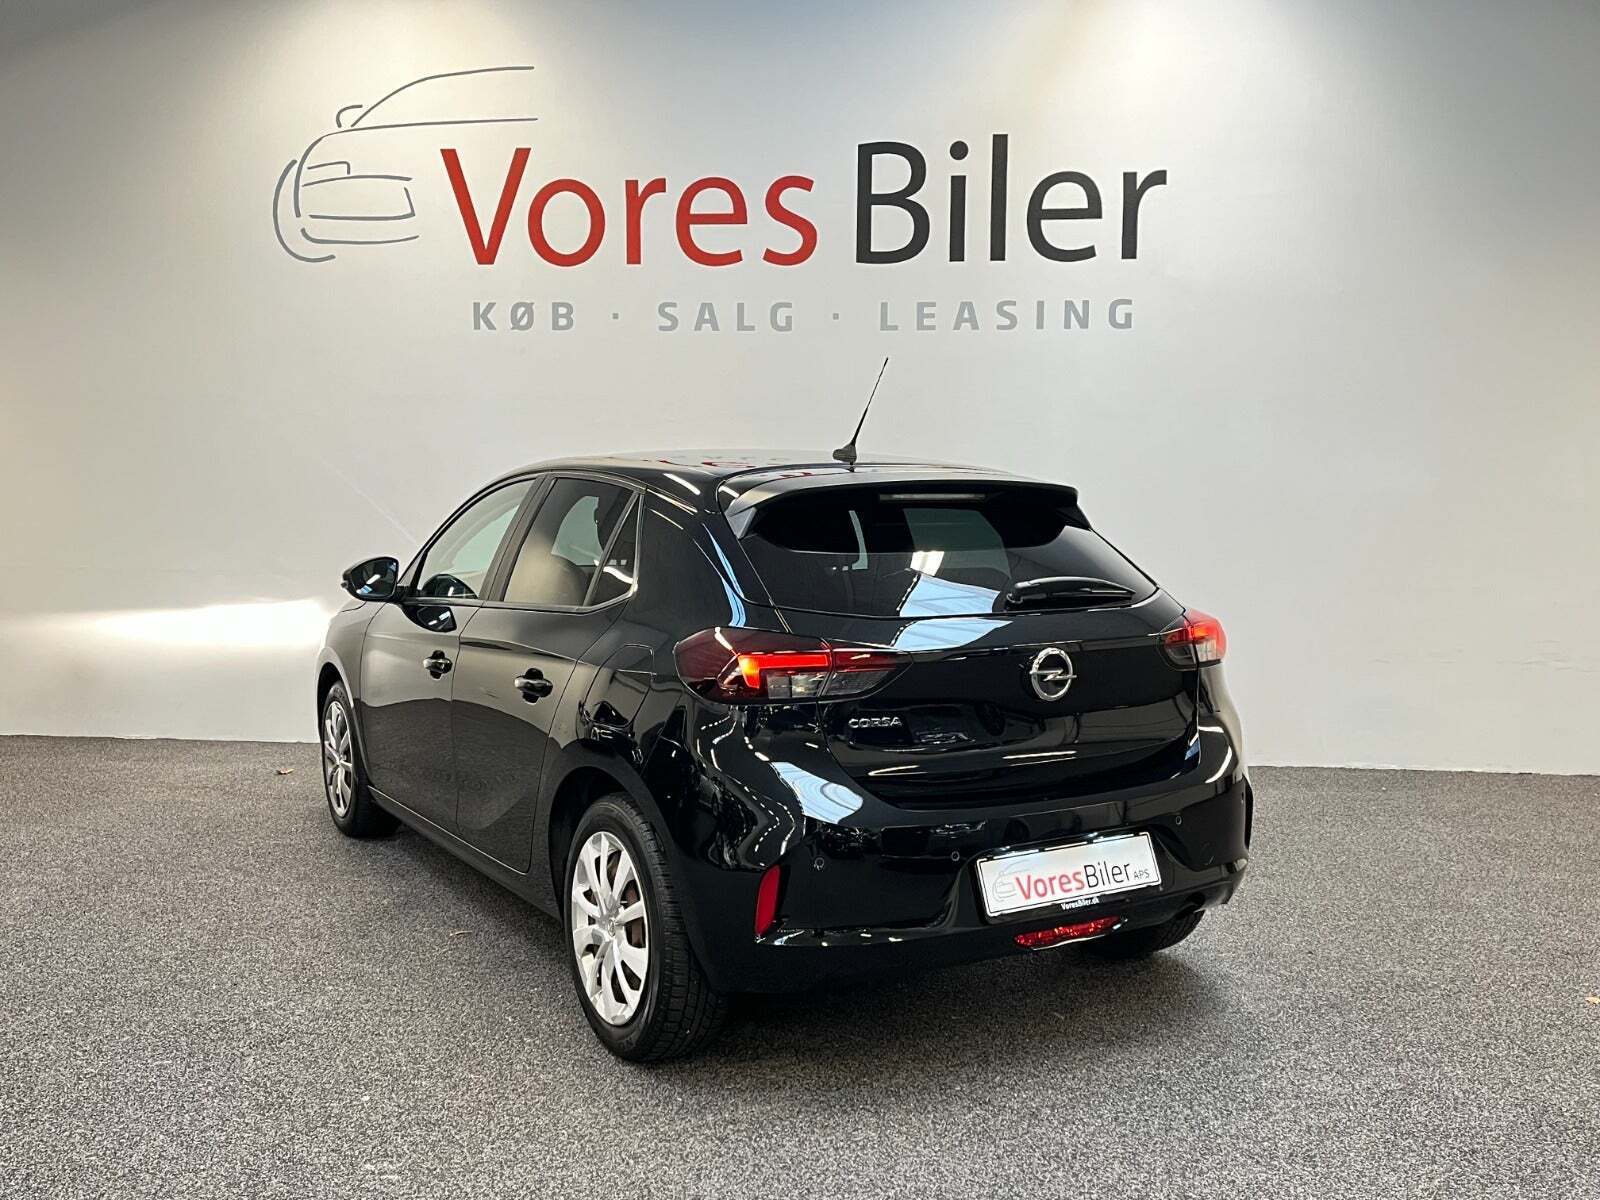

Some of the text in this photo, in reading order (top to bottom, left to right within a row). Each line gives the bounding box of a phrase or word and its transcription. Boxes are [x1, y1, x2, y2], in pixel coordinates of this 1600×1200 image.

[441, 133, 1167, 266] Vores Biler
[473, 298, 1134, 333] KØB SALG LEASING
[848, 717, 902, 728] CORSA
[1015, 861, 1150, 900] VoresBiler APS
[1061, 897, 1100, 910] VoresBiler.dk
